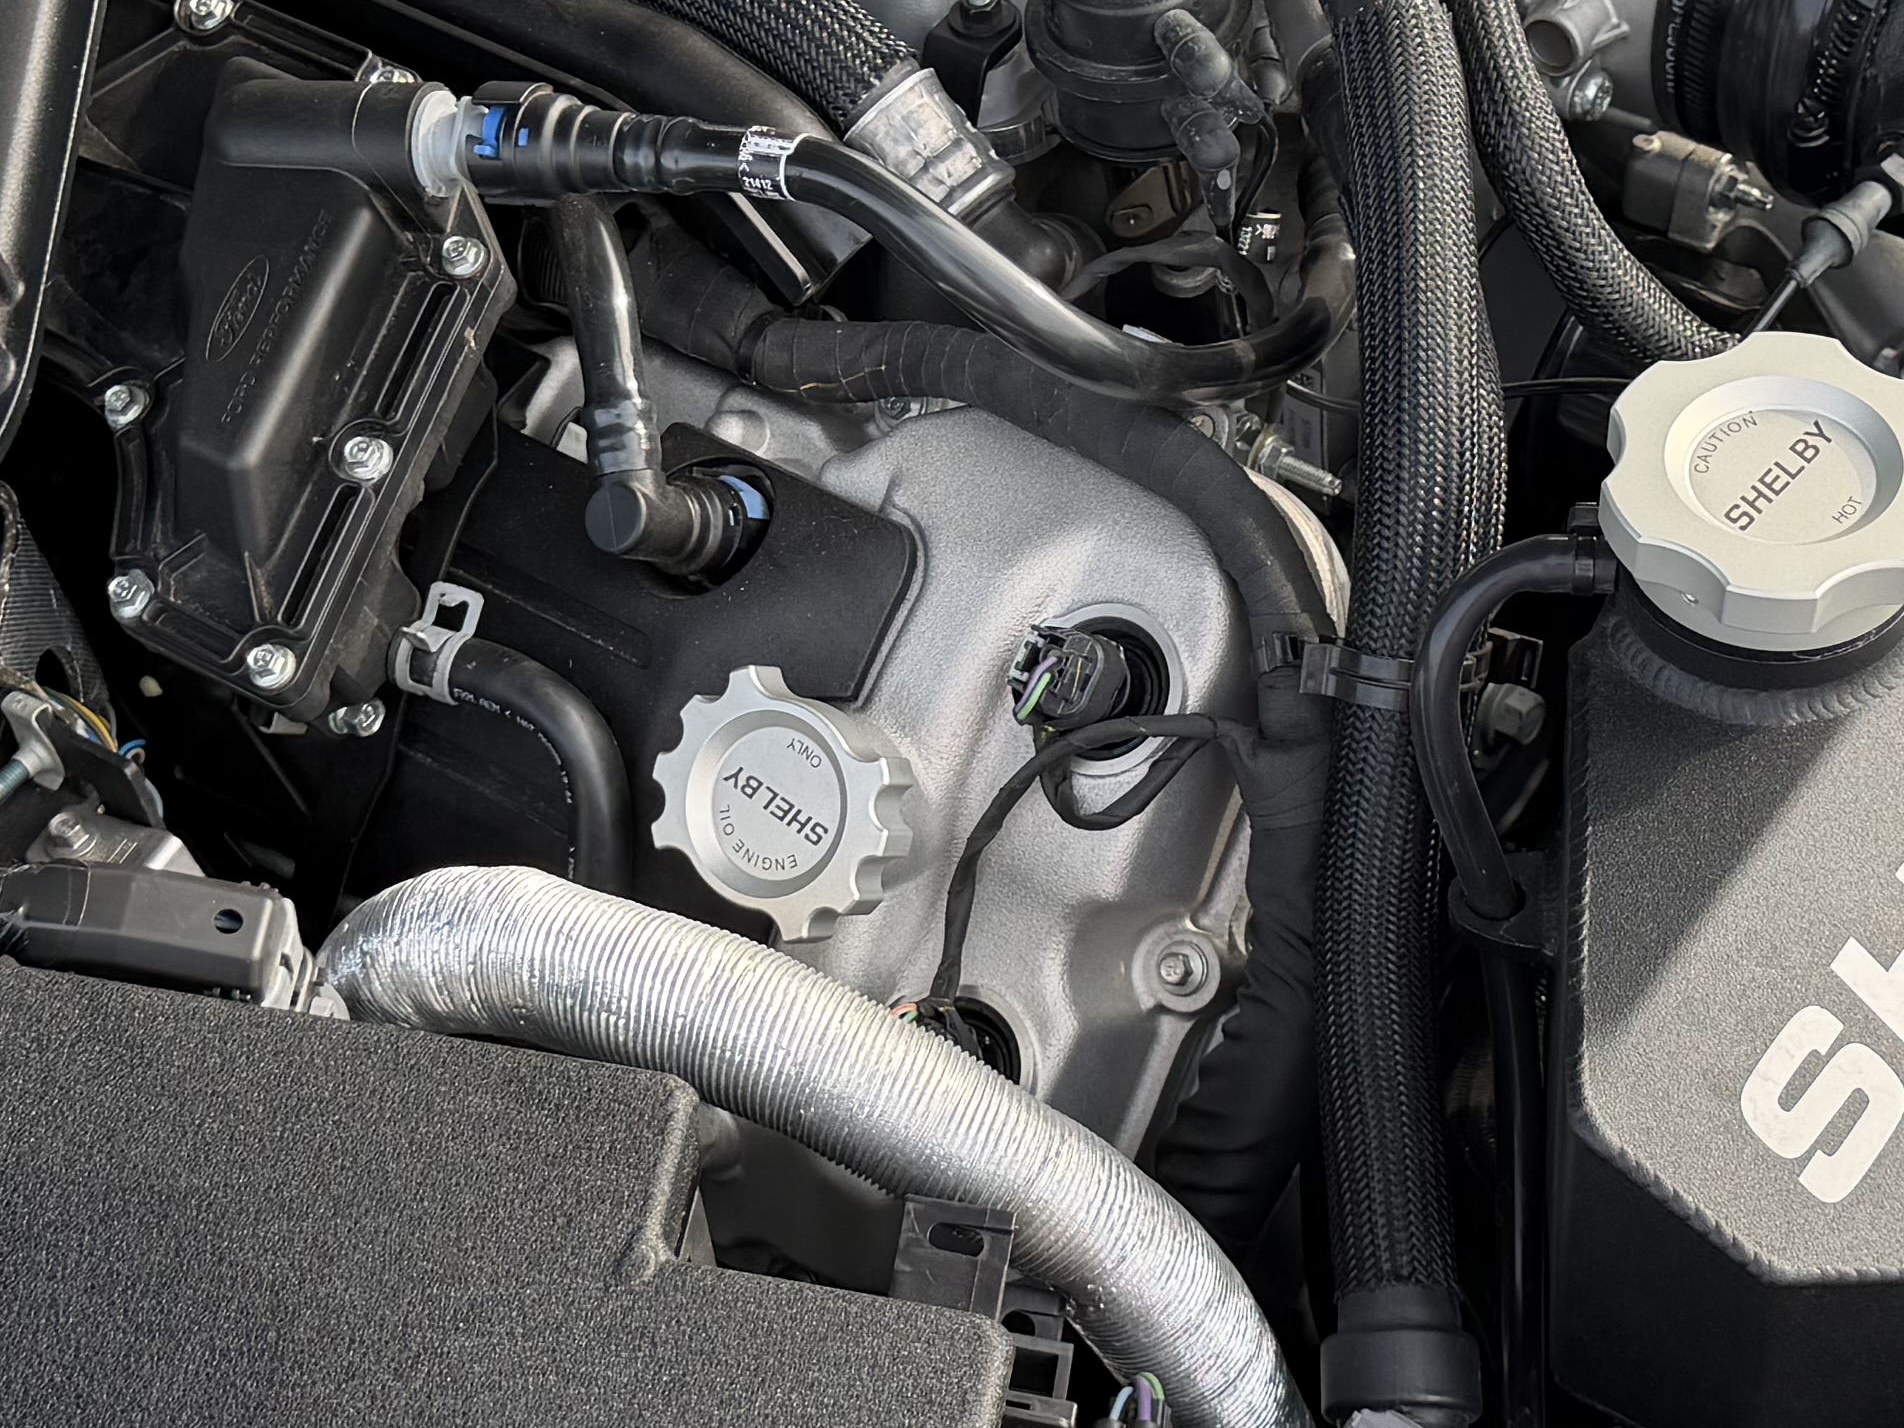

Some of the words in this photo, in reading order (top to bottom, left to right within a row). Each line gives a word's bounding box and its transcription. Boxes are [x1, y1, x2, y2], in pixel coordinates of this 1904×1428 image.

[220, 371, 257, 424] FORD
[1693, 415, 1758, 474] CAUTION
[1723, 419, 1833, 532] SHELBY
[1831, 495, 1864, 525] HOT
[786, 737, 823, 769] ONLY
[719, 803, 736, 837] OIL
[722, 766, 829, 847] SHELBY
[731, 838, 799, 871] ENGINE
